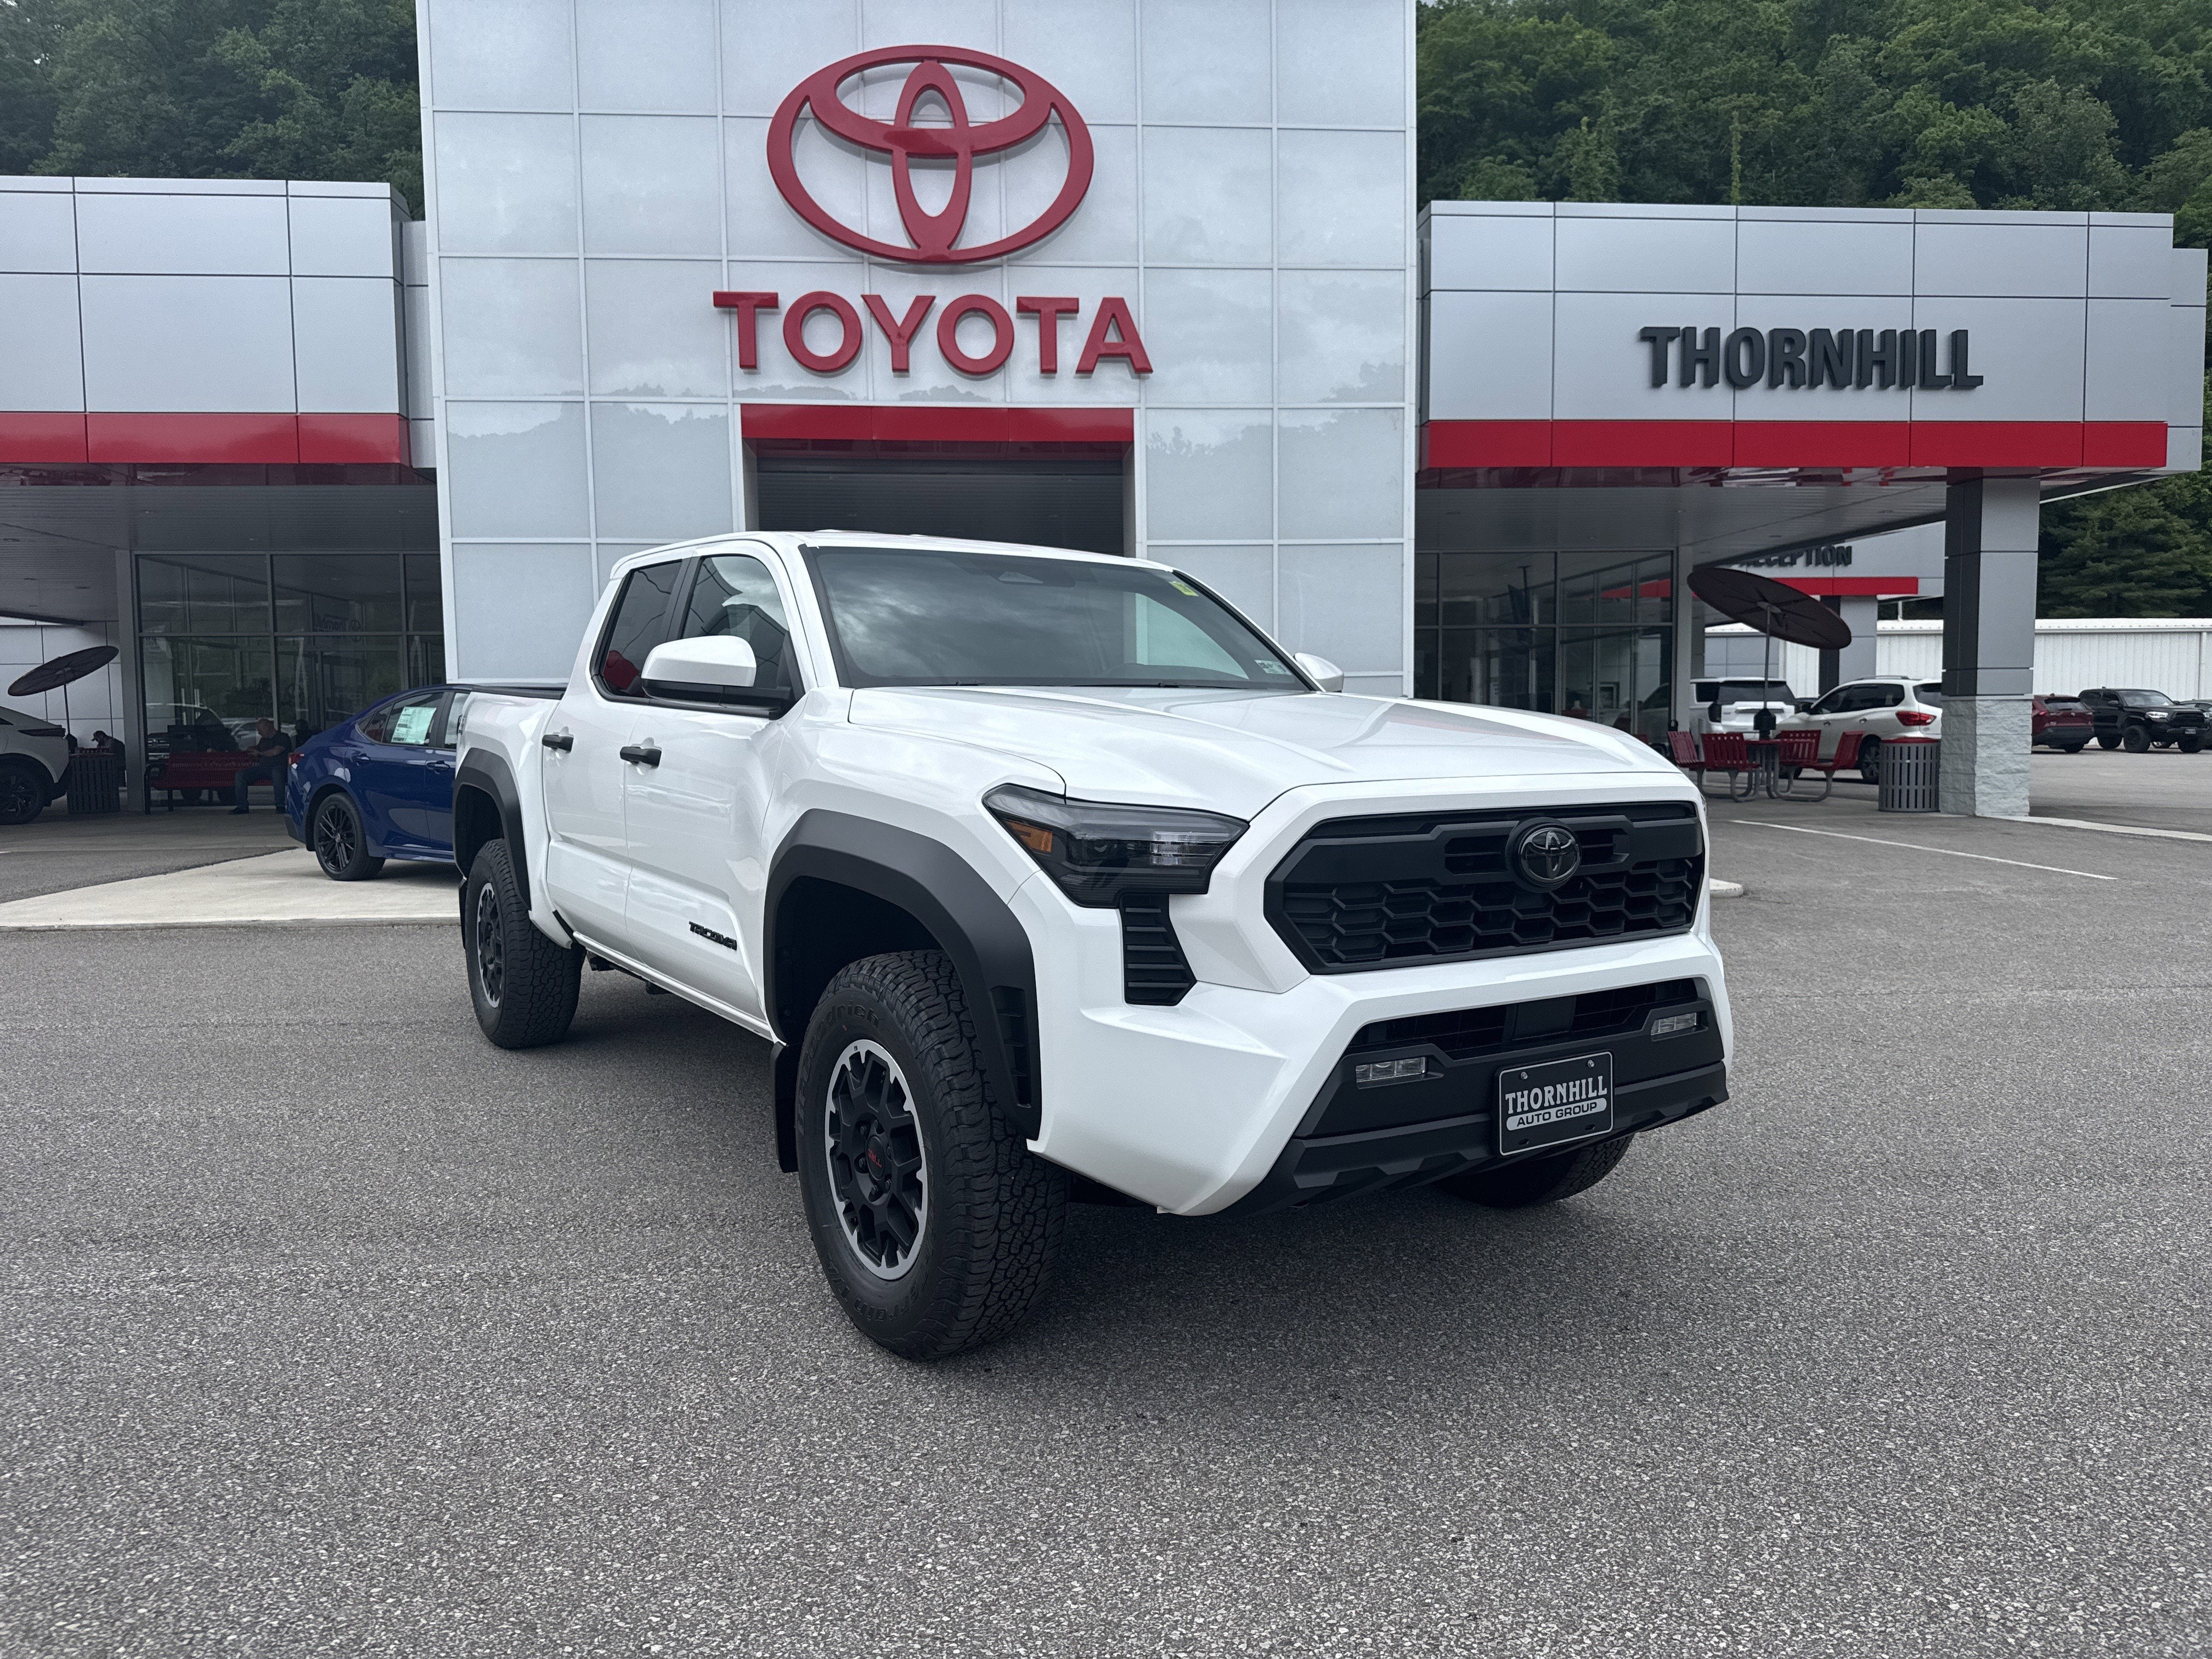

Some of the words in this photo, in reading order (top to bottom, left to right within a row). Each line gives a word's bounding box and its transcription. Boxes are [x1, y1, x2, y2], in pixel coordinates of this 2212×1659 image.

[714, 291, 1153, 374] TOYOTA
[1640, 327, 1983, 389] THORNHILL
[1505, 1075, 1608, 1114] THORNHILL
[1516, 1110, 1552, 1127] AUTO
[1555, 1101, 1598, 1119] GROUP
